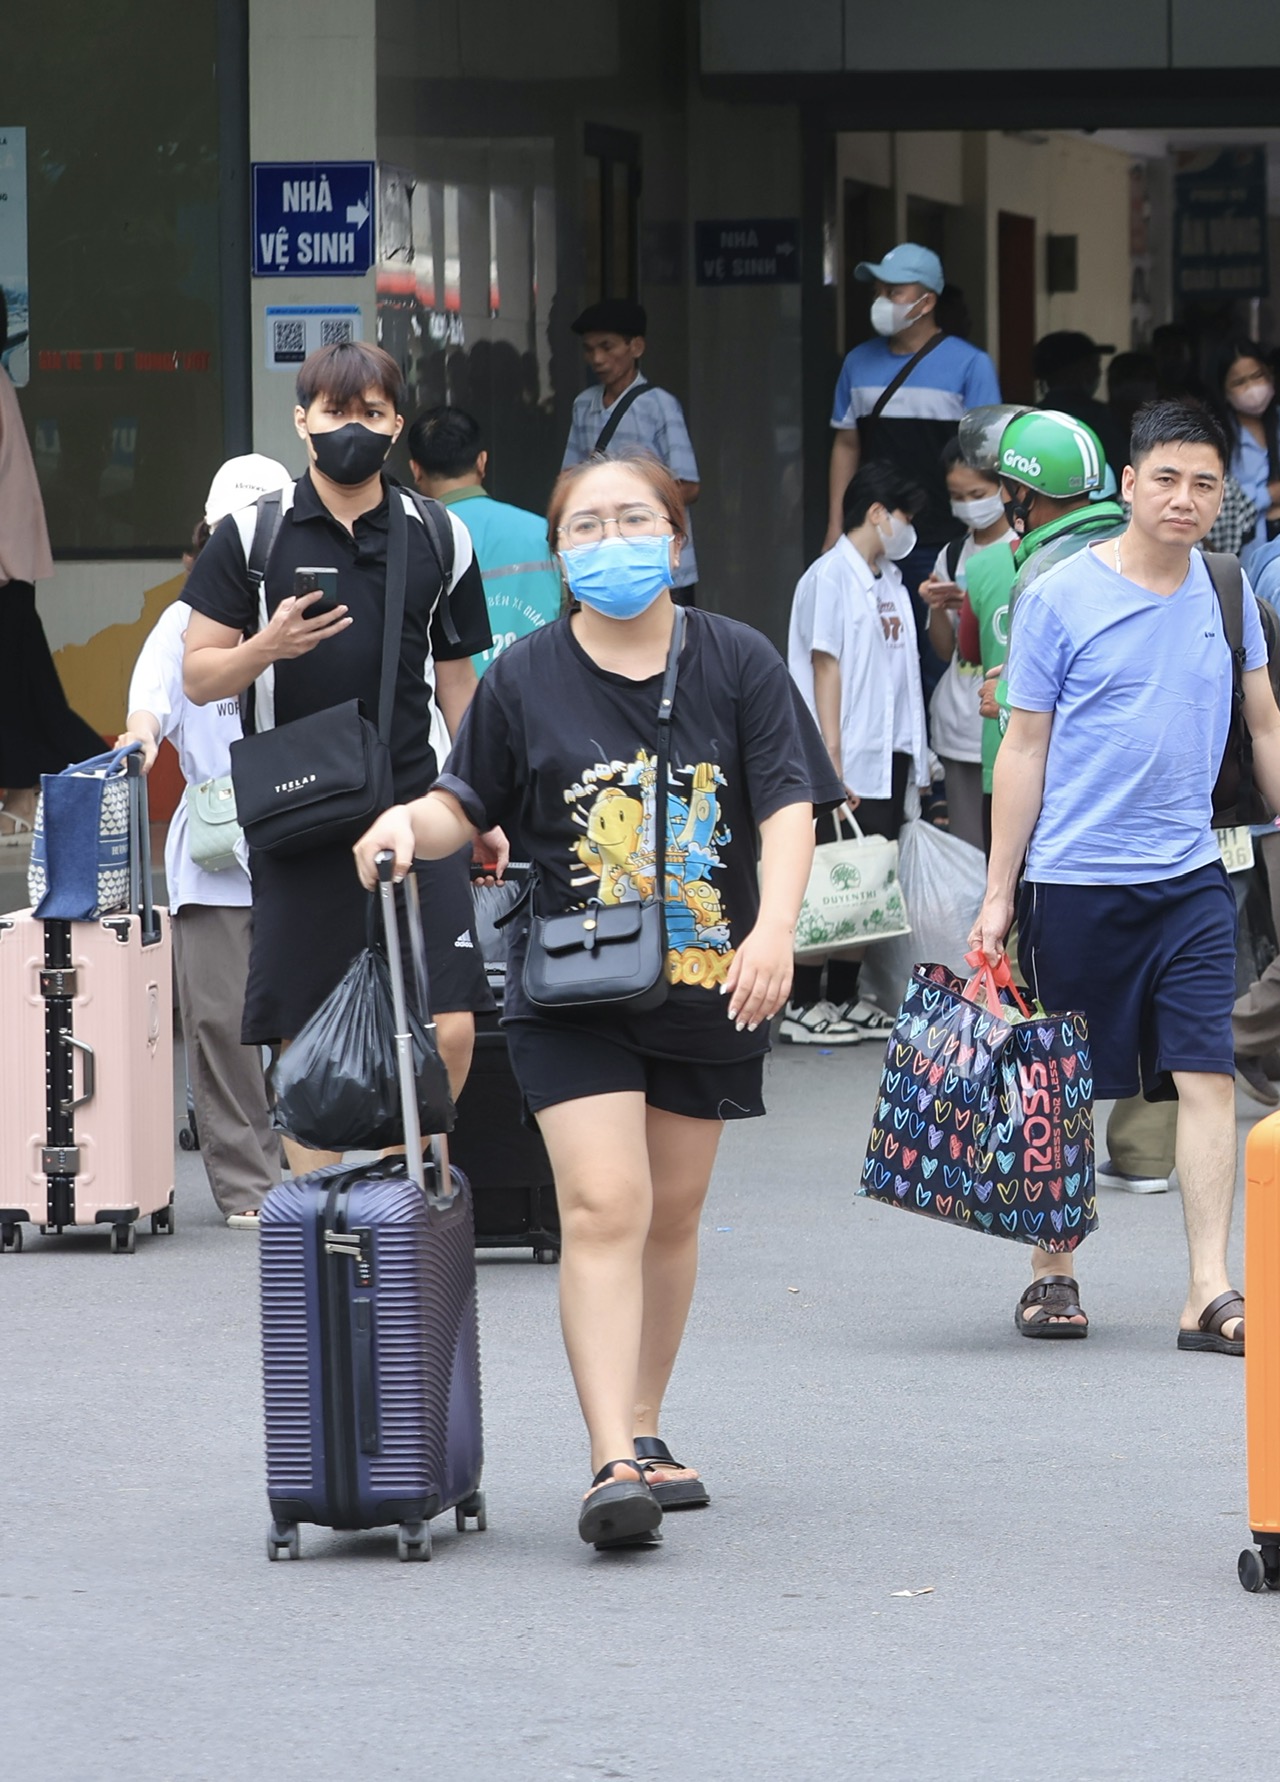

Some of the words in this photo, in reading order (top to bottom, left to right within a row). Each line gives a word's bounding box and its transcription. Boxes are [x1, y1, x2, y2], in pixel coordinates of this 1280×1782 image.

[282, 173, 333, 213] NHÀ
[260, 226, 290, 271] VỆ
[297, 232, 355, 264] SINH
[732, 258, 777, 277] SINH
[1003, 448, 1041, 477] Grab
[275, 774, 316, 793] TEELAB
[1021, 1062, 1053, 1173] ROSS
[1052, 1097, 1061, 1123] FOR
[1053, 1127, 1061, 1169] DRESS
